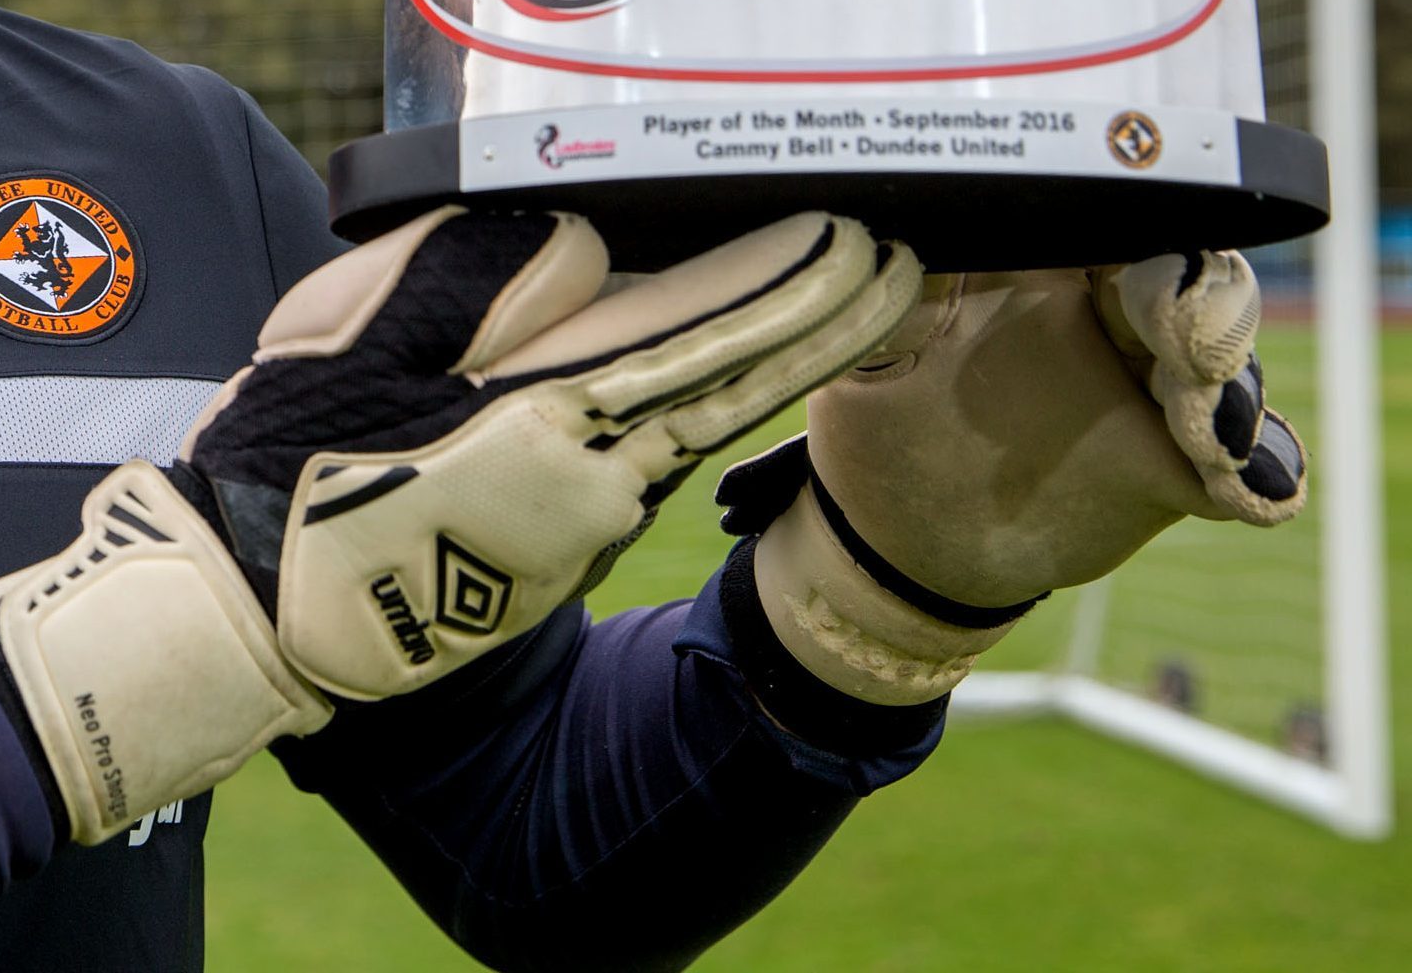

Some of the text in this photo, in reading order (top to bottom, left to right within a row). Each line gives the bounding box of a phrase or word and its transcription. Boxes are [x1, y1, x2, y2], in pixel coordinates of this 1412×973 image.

[643, 108, 1076, 137] Player of the Month September 2016
[695, 135, 1025, 161] Cammy Bell Dundee United
[47, 181, 119, 235] UNITED
[95, 273, 131, 320] CLUB
[371, 573, 435, 665] umbro
[74, 692, 100, 733] Neo
[91, 734, 113, 768] Pro
